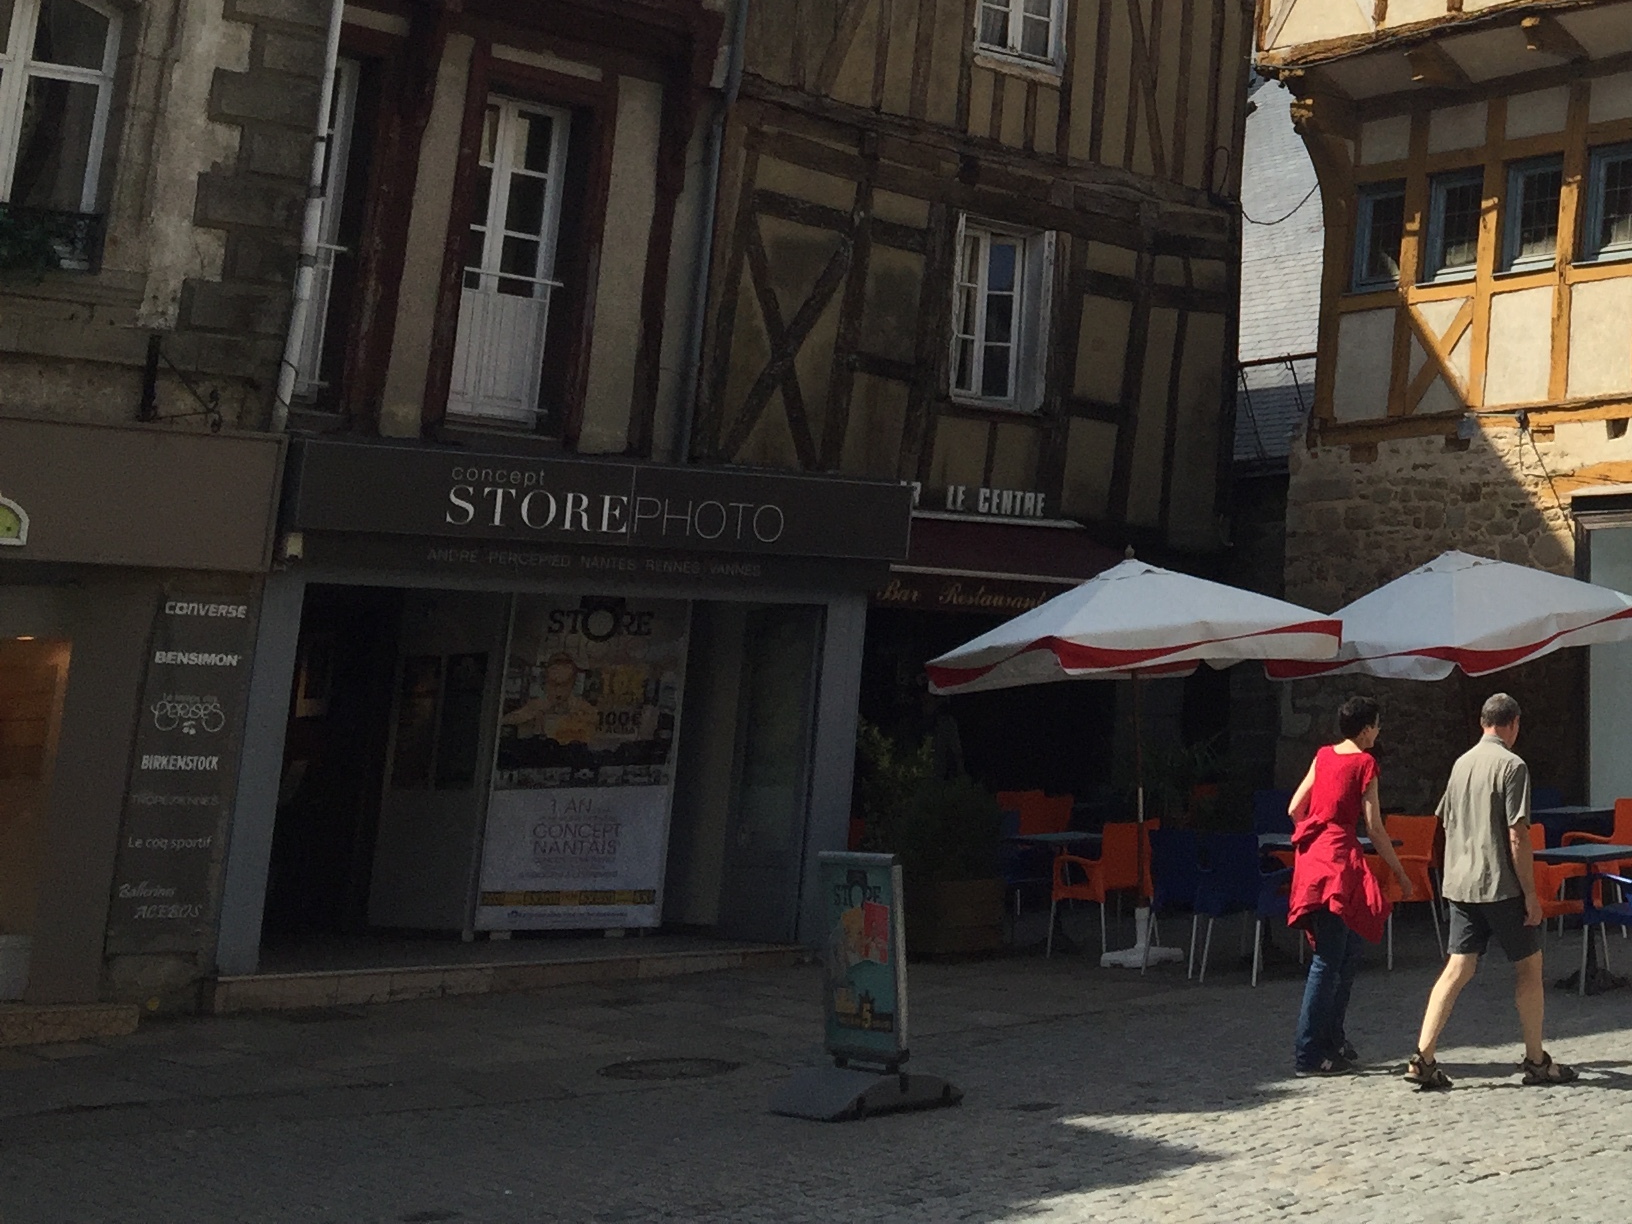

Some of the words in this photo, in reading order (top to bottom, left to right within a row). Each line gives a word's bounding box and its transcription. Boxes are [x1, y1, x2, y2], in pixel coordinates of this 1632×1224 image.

[451, 466, 545, 488] concept
[945, 485, 967, 510] LE
[978, 487, 1046, 517] CENTRE
[445, 484, 630, 534] STORE
[633, 496, 784, 543] PHOTO
[580, 554, 637, 571] NANTES
[877, 579, 919, 603] Bar
[165, 601, 248, 618] CONVERSE
[548, 607, 655, 642] STORE
[155, 651, 239, 666] BENSIMON
[141, 755, 219, 770] BIRKENSTOCK
[533, 822, 621, 839] CONCEPT
[128, 836, 143, 848] Le
[145, 838, 169, 851] coq
[171, 835, 213, 852] sportif
[533, 839, 618, 855] NANTAIS
